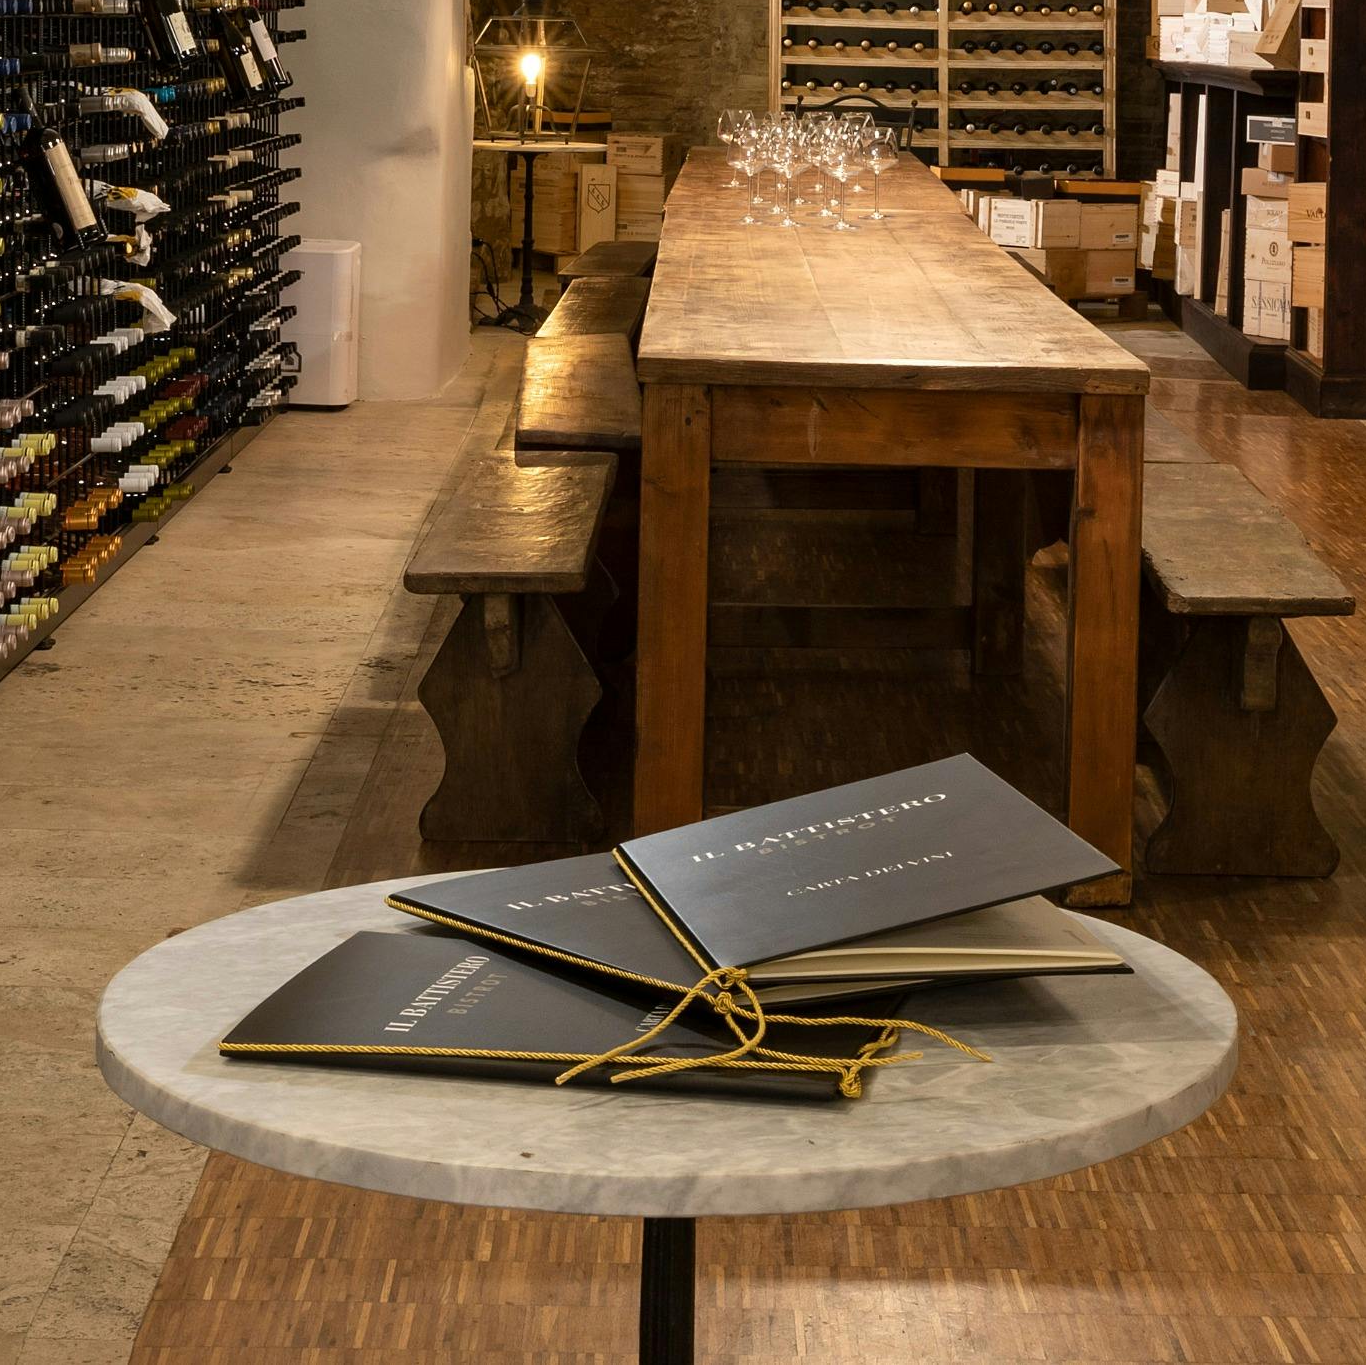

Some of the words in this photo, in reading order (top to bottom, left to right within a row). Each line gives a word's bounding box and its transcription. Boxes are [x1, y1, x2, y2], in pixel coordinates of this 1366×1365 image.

[692, 851, 725, 863] IL
[734, 793, 947, 852] BATTISTERO
[758, 815, 897, 856] BISTROT
[787, 875, 860, 897] CARTA
[865, 863, 903, 877] DEI
[907, 851, 953, 866] VINI
[506, 900, 543, 911] IL
[399, 955, 491, 1018] BATTISTERO
[446, 972, 508, 1015] BISTROT
[384, 1017, 418, 1034] IL
